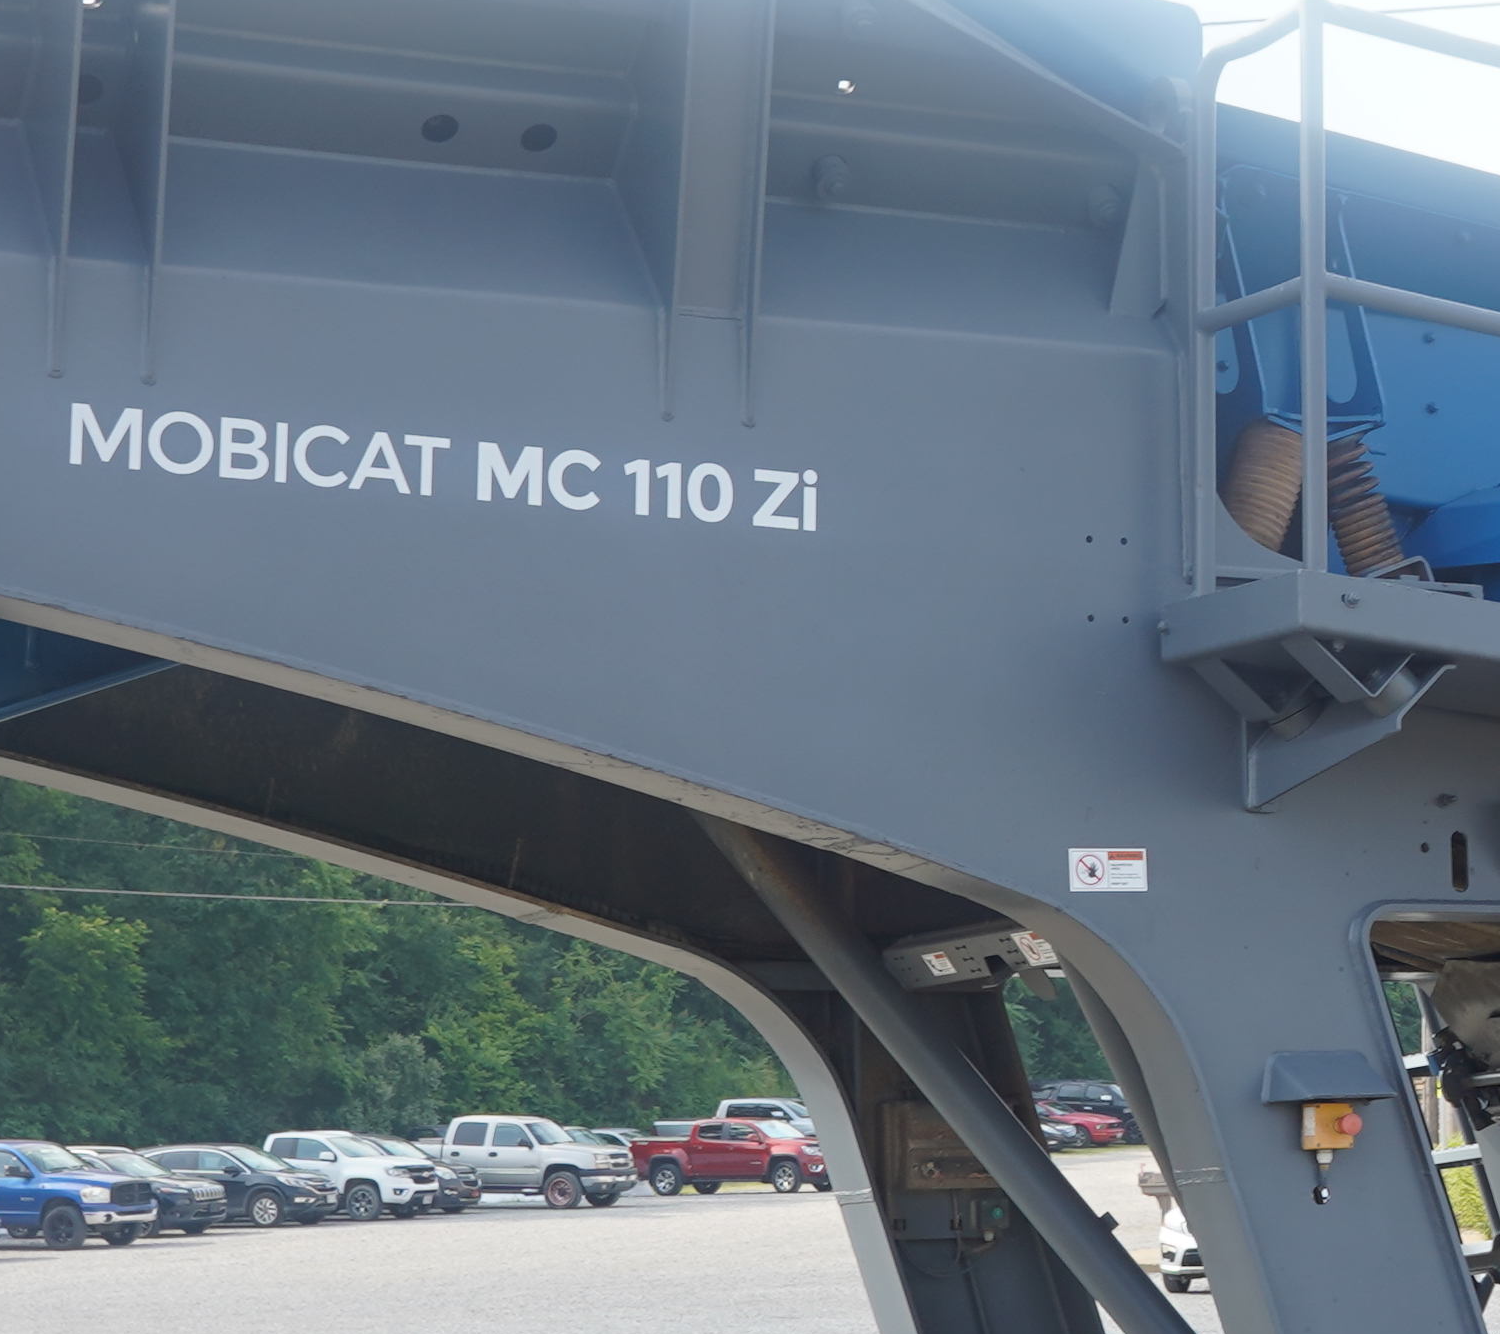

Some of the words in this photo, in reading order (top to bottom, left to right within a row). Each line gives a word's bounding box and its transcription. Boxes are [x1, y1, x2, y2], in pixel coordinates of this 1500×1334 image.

[67, 401, 451, 497] MOBICAT
[476, 441, 603, 511] MC
[623, 458, 735, 525] 110
[751, 467, 820, 533] Zi
